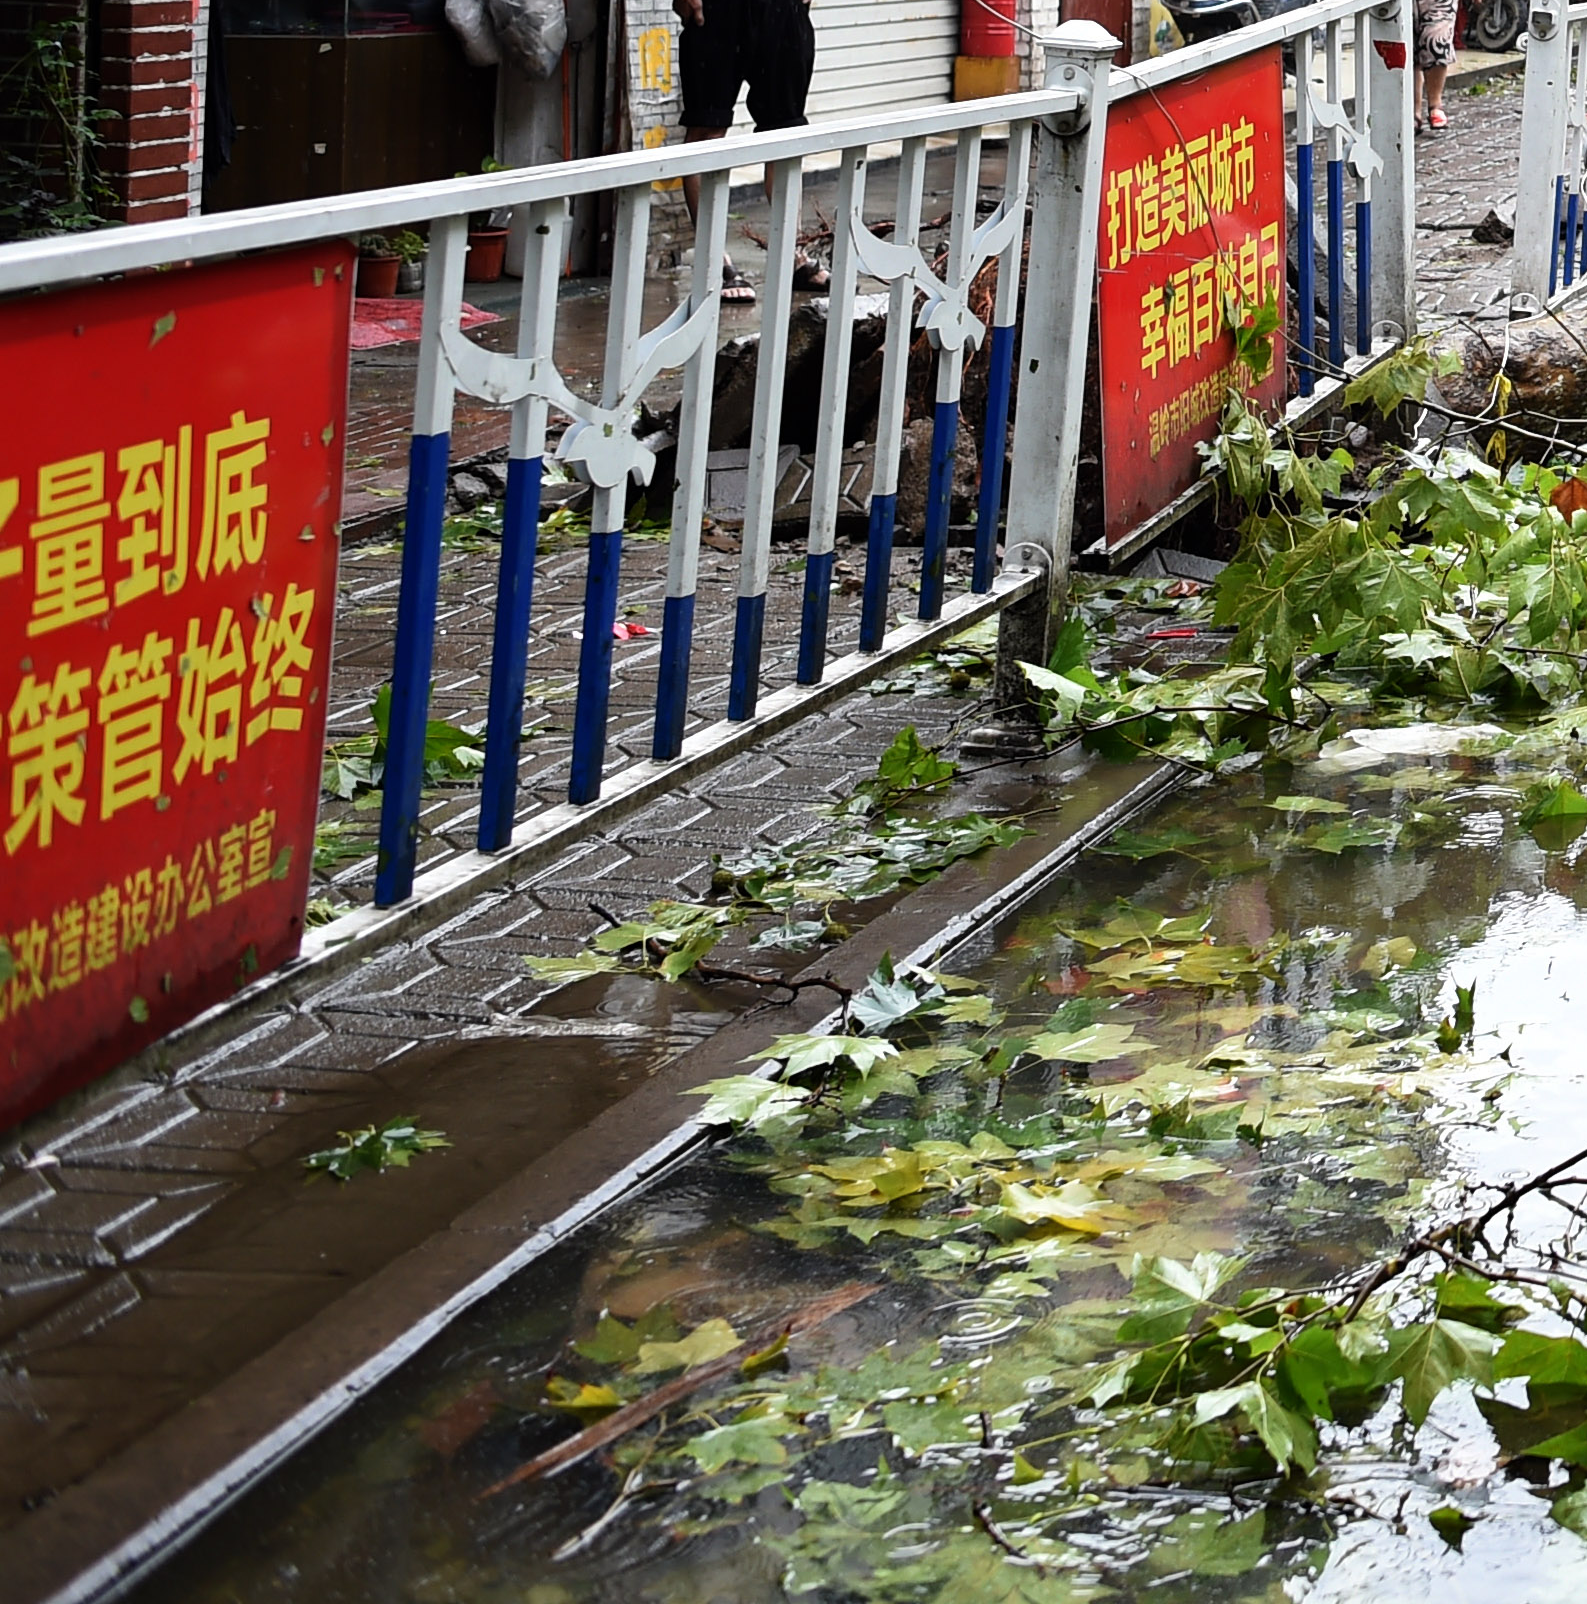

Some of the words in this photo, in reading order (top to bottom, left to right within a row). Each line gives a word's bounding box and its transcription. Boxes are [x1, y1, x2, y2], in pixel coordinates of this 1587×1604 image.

[1107, 115, 1255, 269] 打造美丽城市
[1141, 220, 1281, 380] 幸福百姓自己
[0, 807, 277, 1024] 改造建设办公室宣
